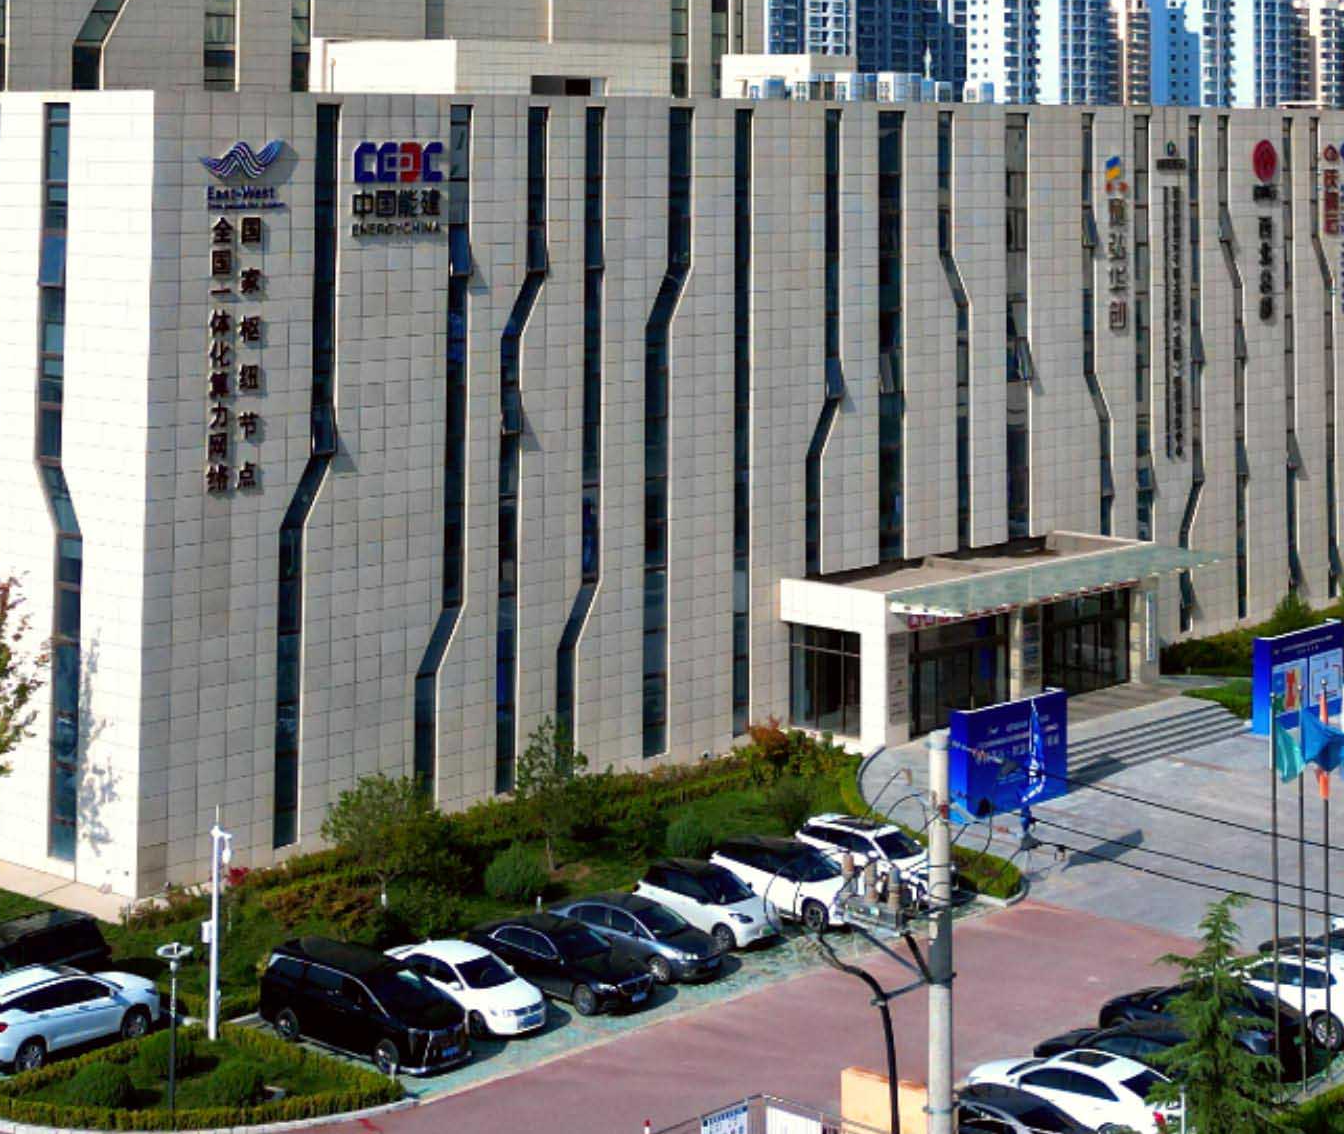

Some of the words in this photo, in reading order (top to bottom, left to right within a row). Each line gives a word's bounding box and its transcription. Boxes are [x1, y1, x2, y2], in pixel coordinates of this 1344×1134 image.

[352, 189, 441, 218] 中国能建
[207, 216, 234, 491] 全国一体化算力网络
[237, 216, 262, 490] 国家枢纽节点
